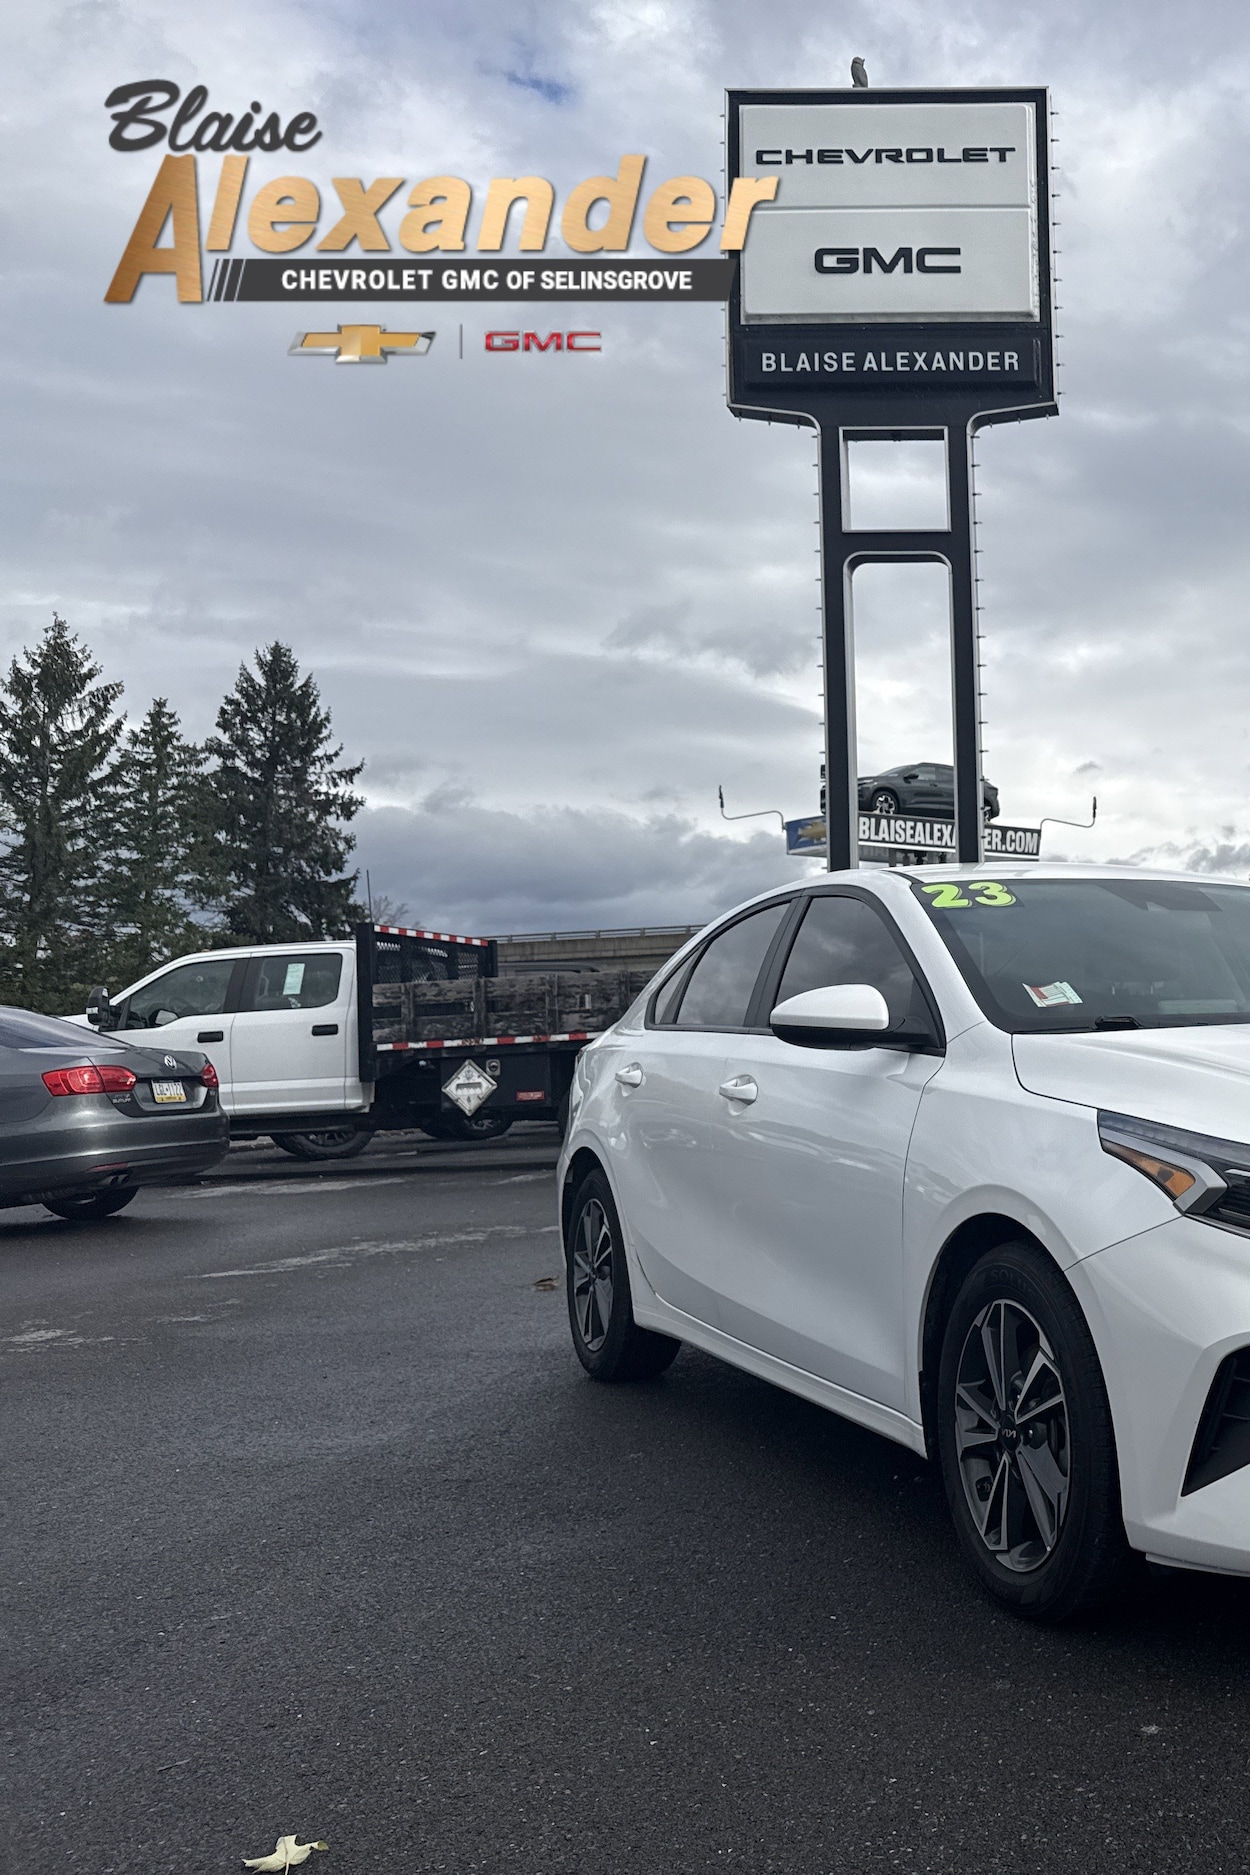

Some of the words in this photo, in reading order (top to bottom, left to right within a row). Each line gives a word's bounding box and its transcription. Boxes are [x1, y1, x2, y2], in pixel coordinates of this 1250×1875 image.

[755, 147, 1016, 165] CHEVROLET
[814, 247, 962, 274] GMC
[761, 351, 856, 373] BLAISE
[862, 350, 1020, 372] ALEXANDER
[921, 881, 1017, 909] 23
